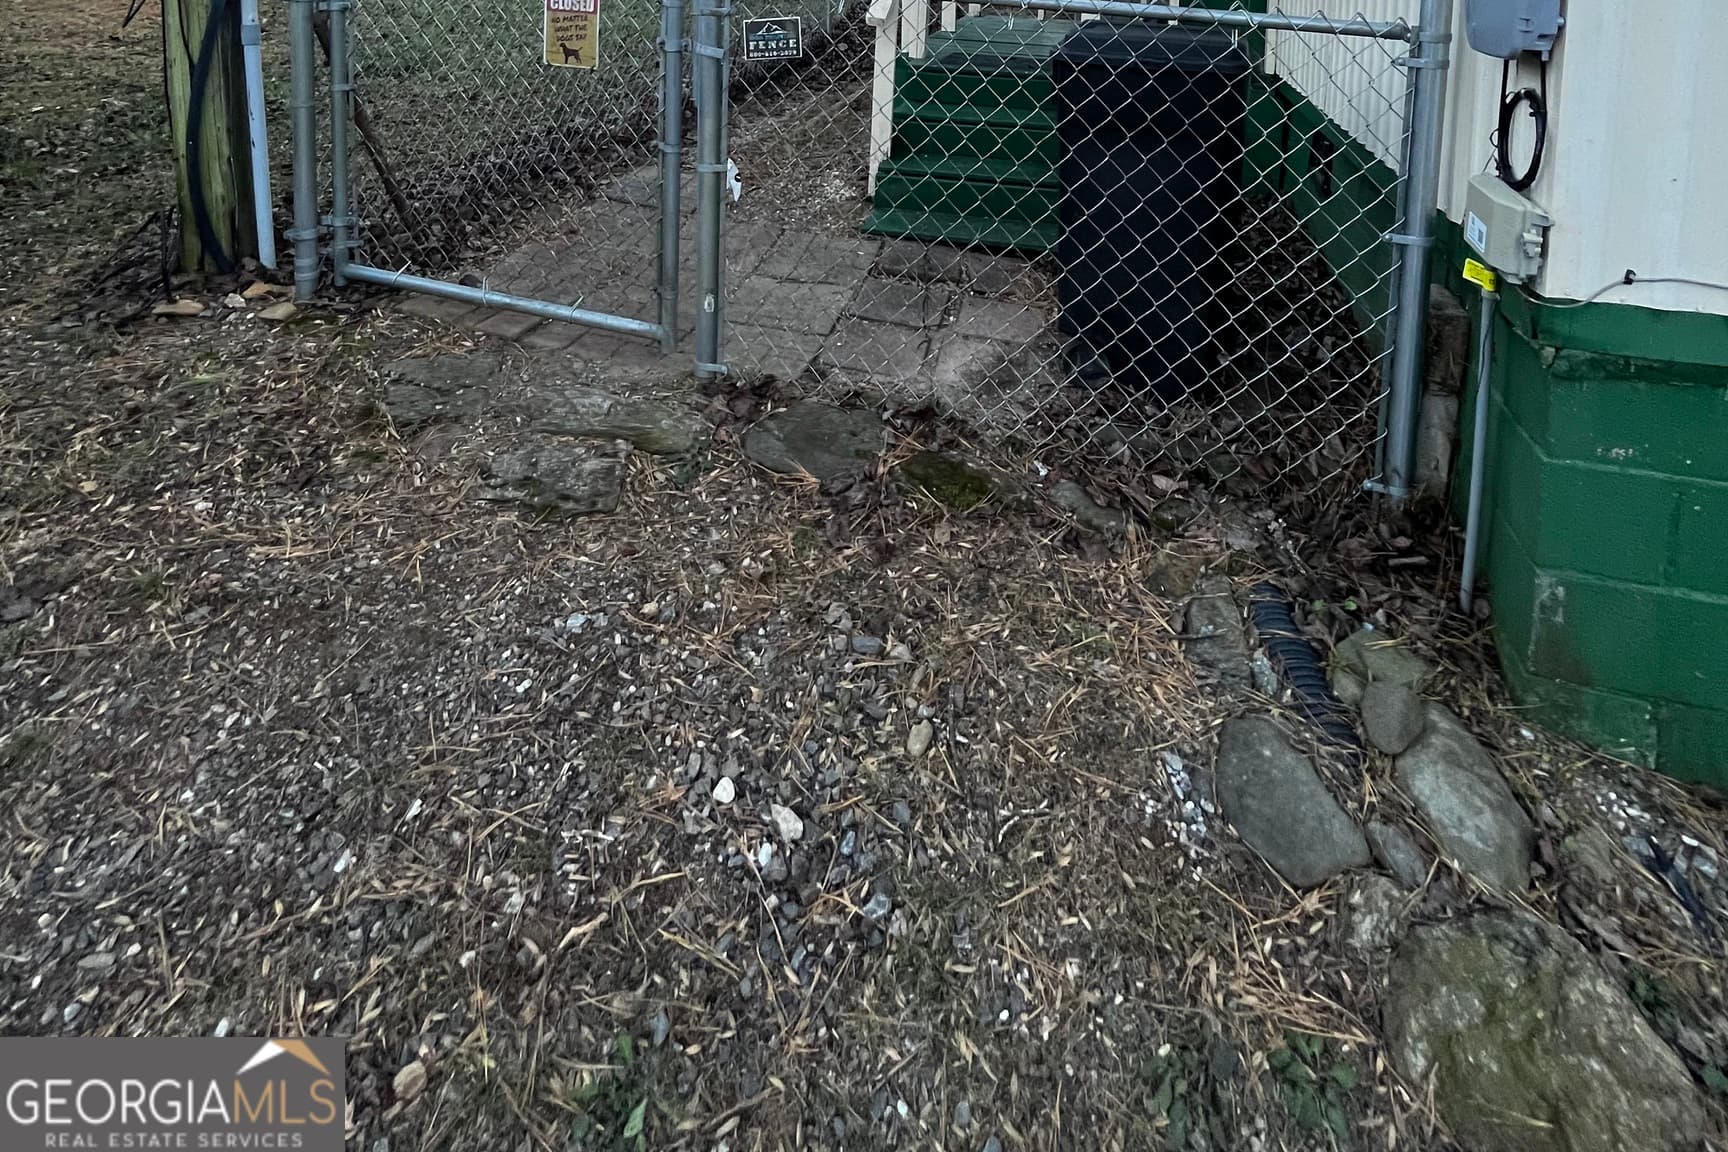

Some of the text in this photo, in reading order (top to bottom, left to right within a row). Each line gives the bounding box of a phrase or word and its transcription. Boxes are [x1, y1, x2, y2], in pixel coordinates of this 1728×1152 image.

[562, 14, 588, 23] MATTER
[554, 23, 588, 33] WHAT THE
[556, 34, 575, 42] DOGS
[749, 39, 797, 50] FENCE
